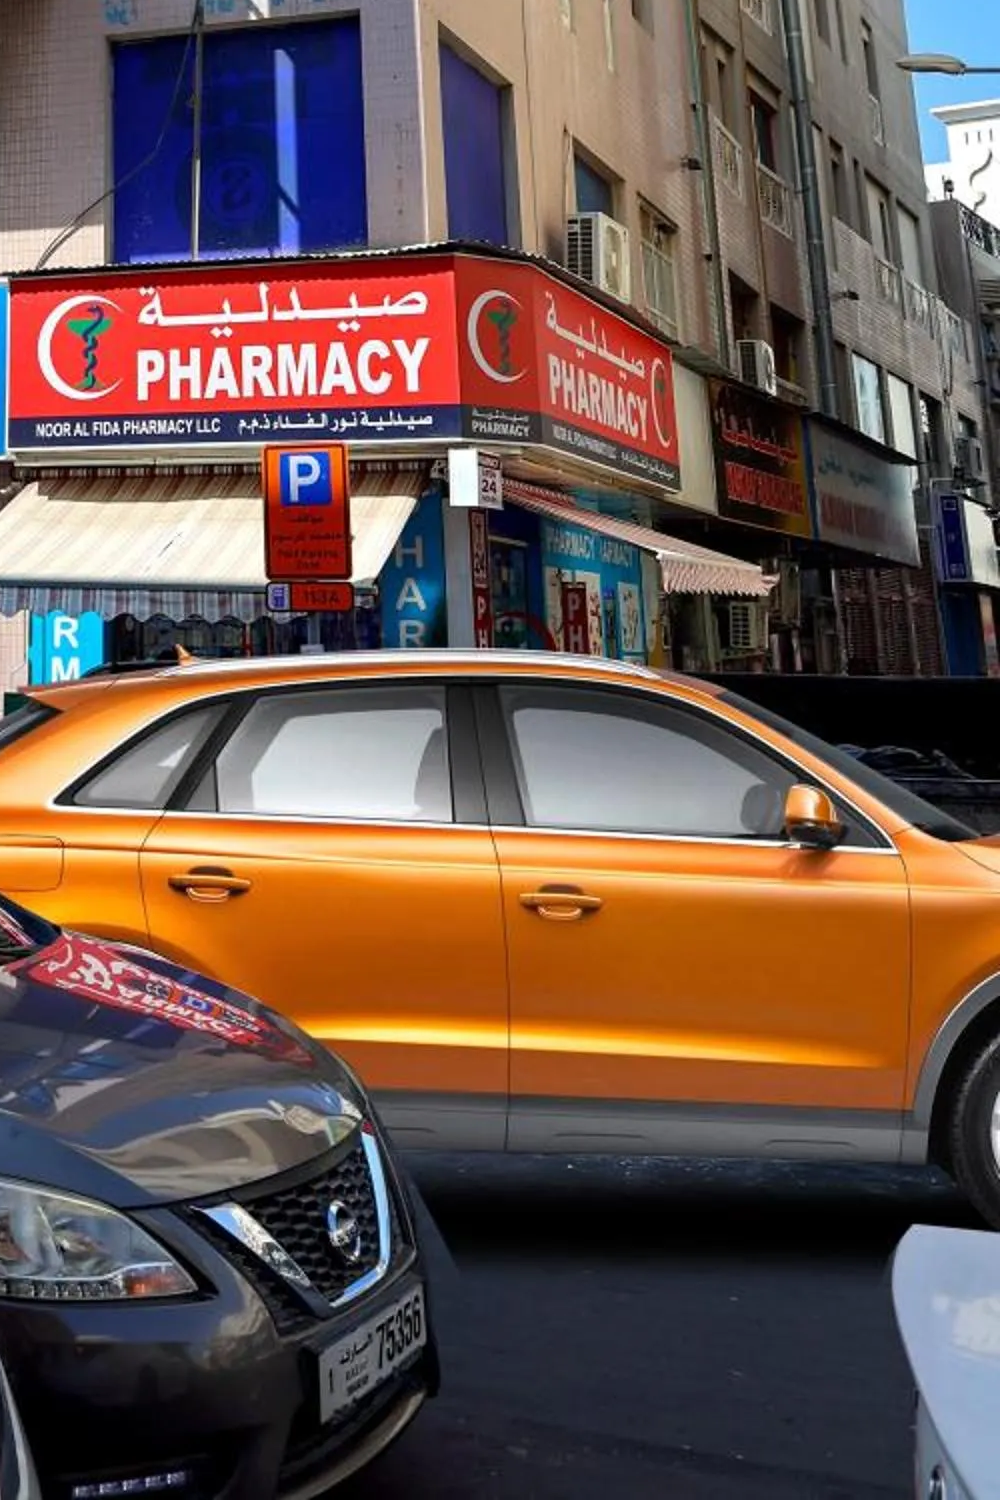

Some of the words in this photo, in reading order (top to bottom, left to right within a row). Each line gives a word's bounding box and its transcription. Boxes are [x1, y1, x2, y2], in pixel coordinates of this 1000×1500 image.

[138, 282, 428, 338] صيدلية
[544, 291, 646, 383] صيدلية
[136, 337, 430, 402] PHARMACY
[361, 408, 434, 432] صيدلية
[547, 352, 649, 443] PHARMACY
[35, 422, 71, 438] NOOR
[73, 422, 90, 437] AL
[92, 420, 121, 436] FIDA
[123, 418, 193, 435] PHARMACY
[196, 417, 221, 433] LLC
[471, 419, 531, 438] PHARMACY
[287, 454, 322, 504] P
[481, 479, 497, 494] 24
[376, 1294, 422, 1370] 75356
